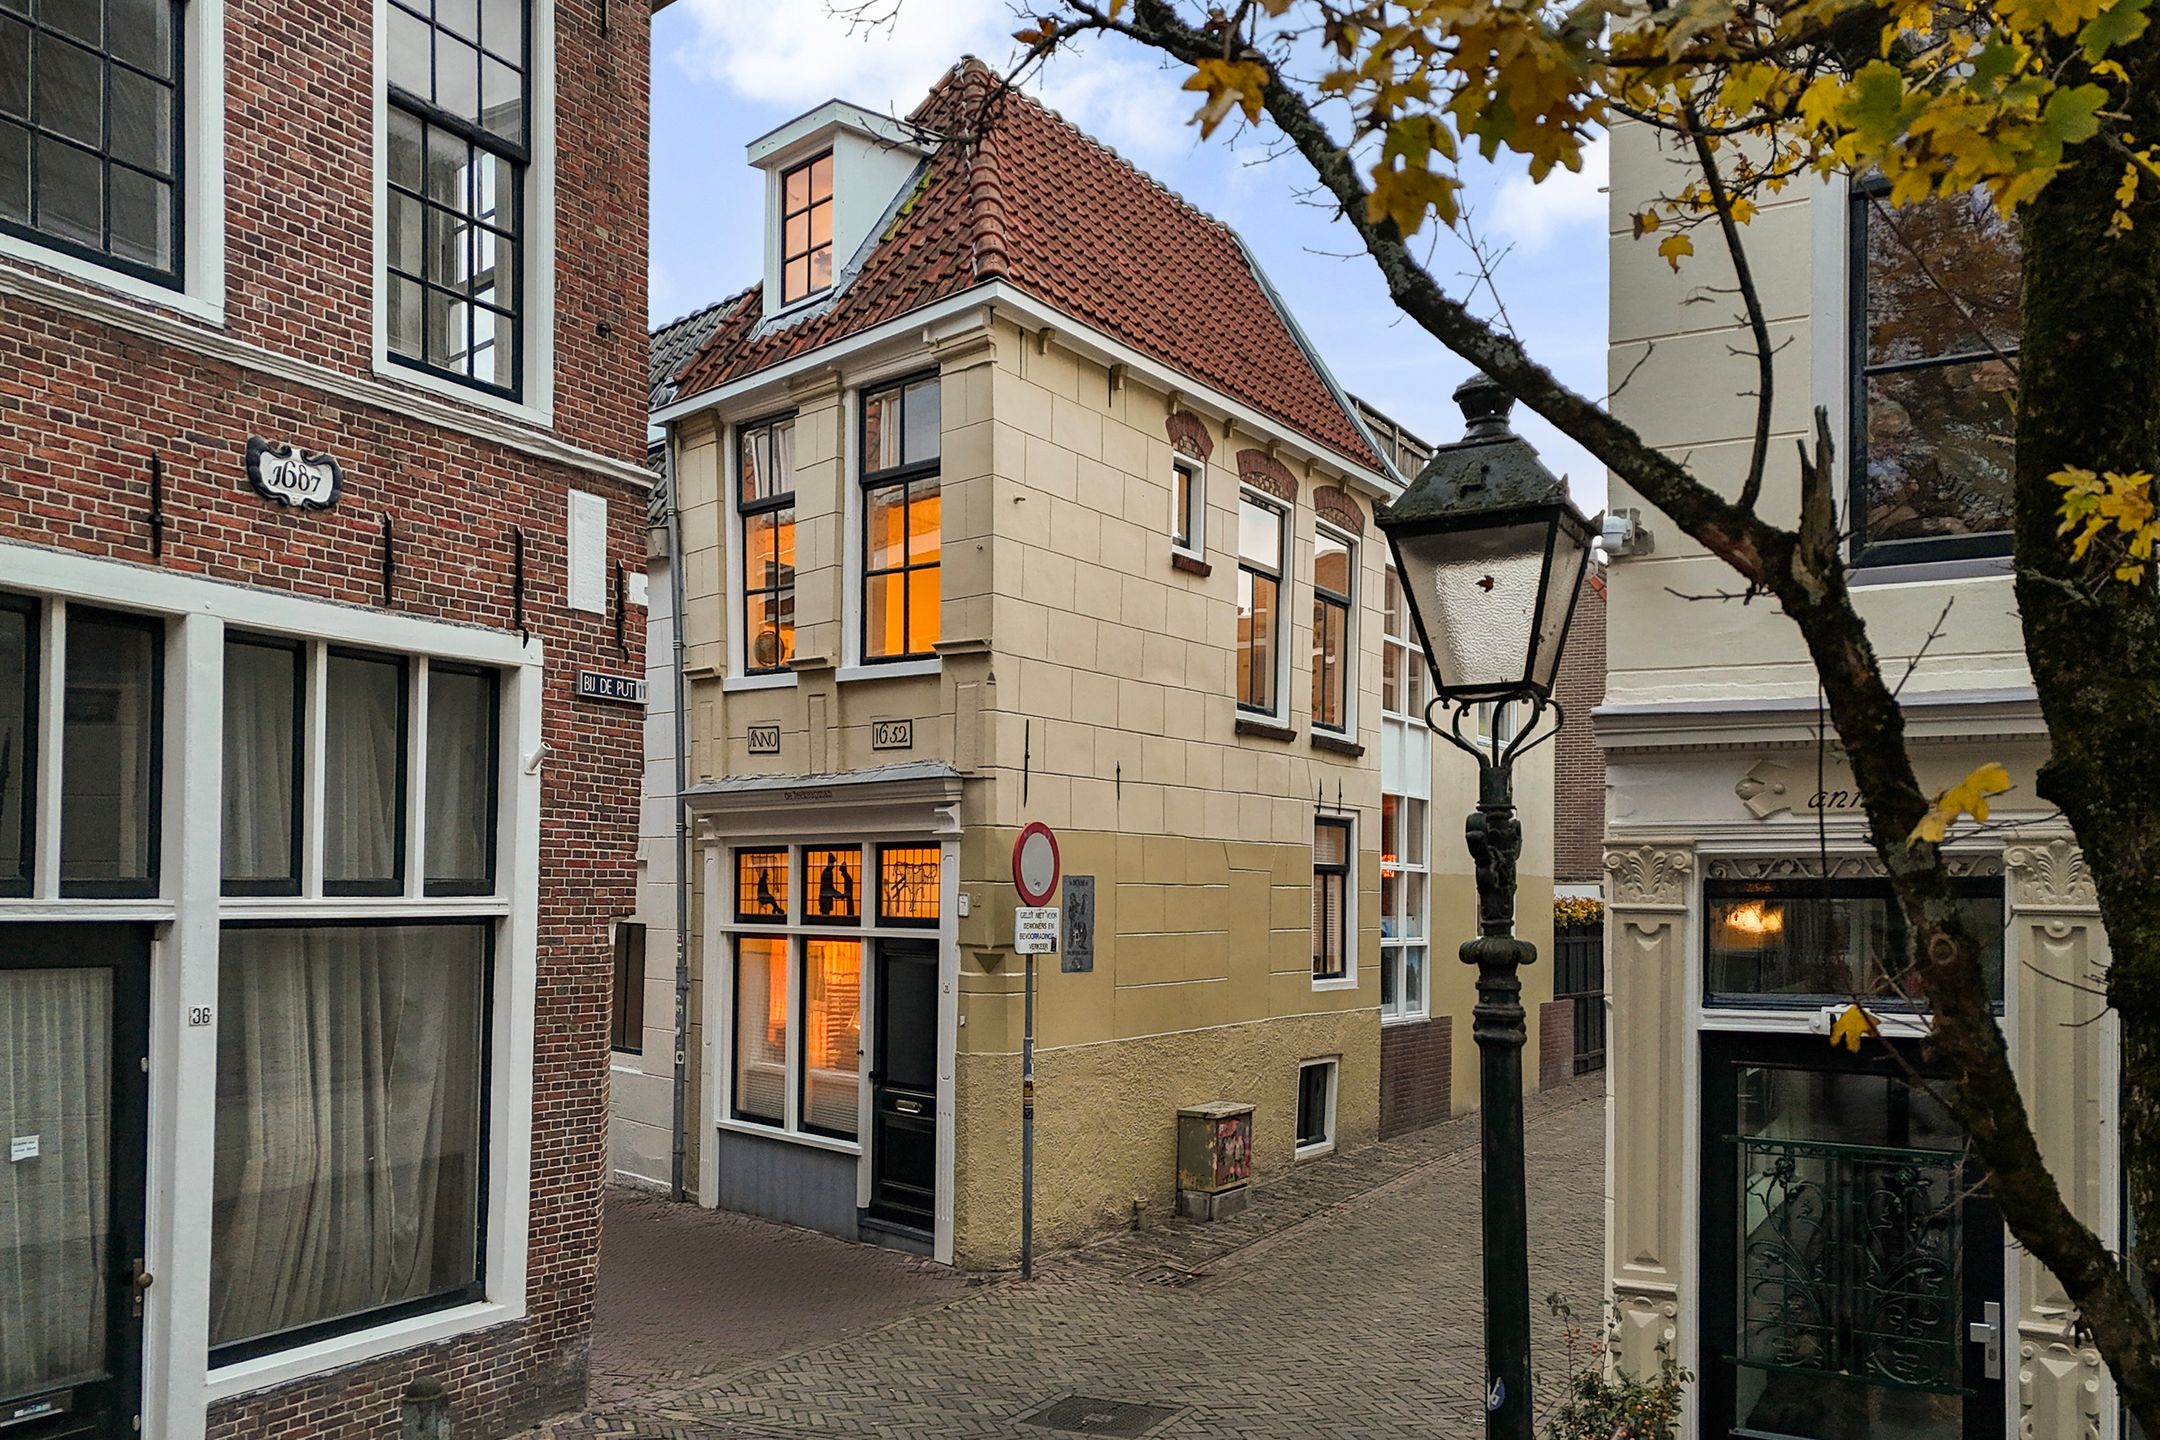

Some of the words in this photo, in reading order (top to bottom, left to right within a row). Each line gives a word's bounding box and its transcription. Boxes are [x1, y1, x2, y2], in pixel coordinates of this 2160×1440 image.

[268, 460, 321, 492] 1687
[584, 675, 596, 692] BIJ
[600, 678, 612, 695] DE
[616, 681, 635, 698] PUT
[638, 684, 646, 699] 11
[749, 730, 777, 747] ANNO
[875, 723, 908, 744] 1652
[192, 1007, 210, 1024] 36
